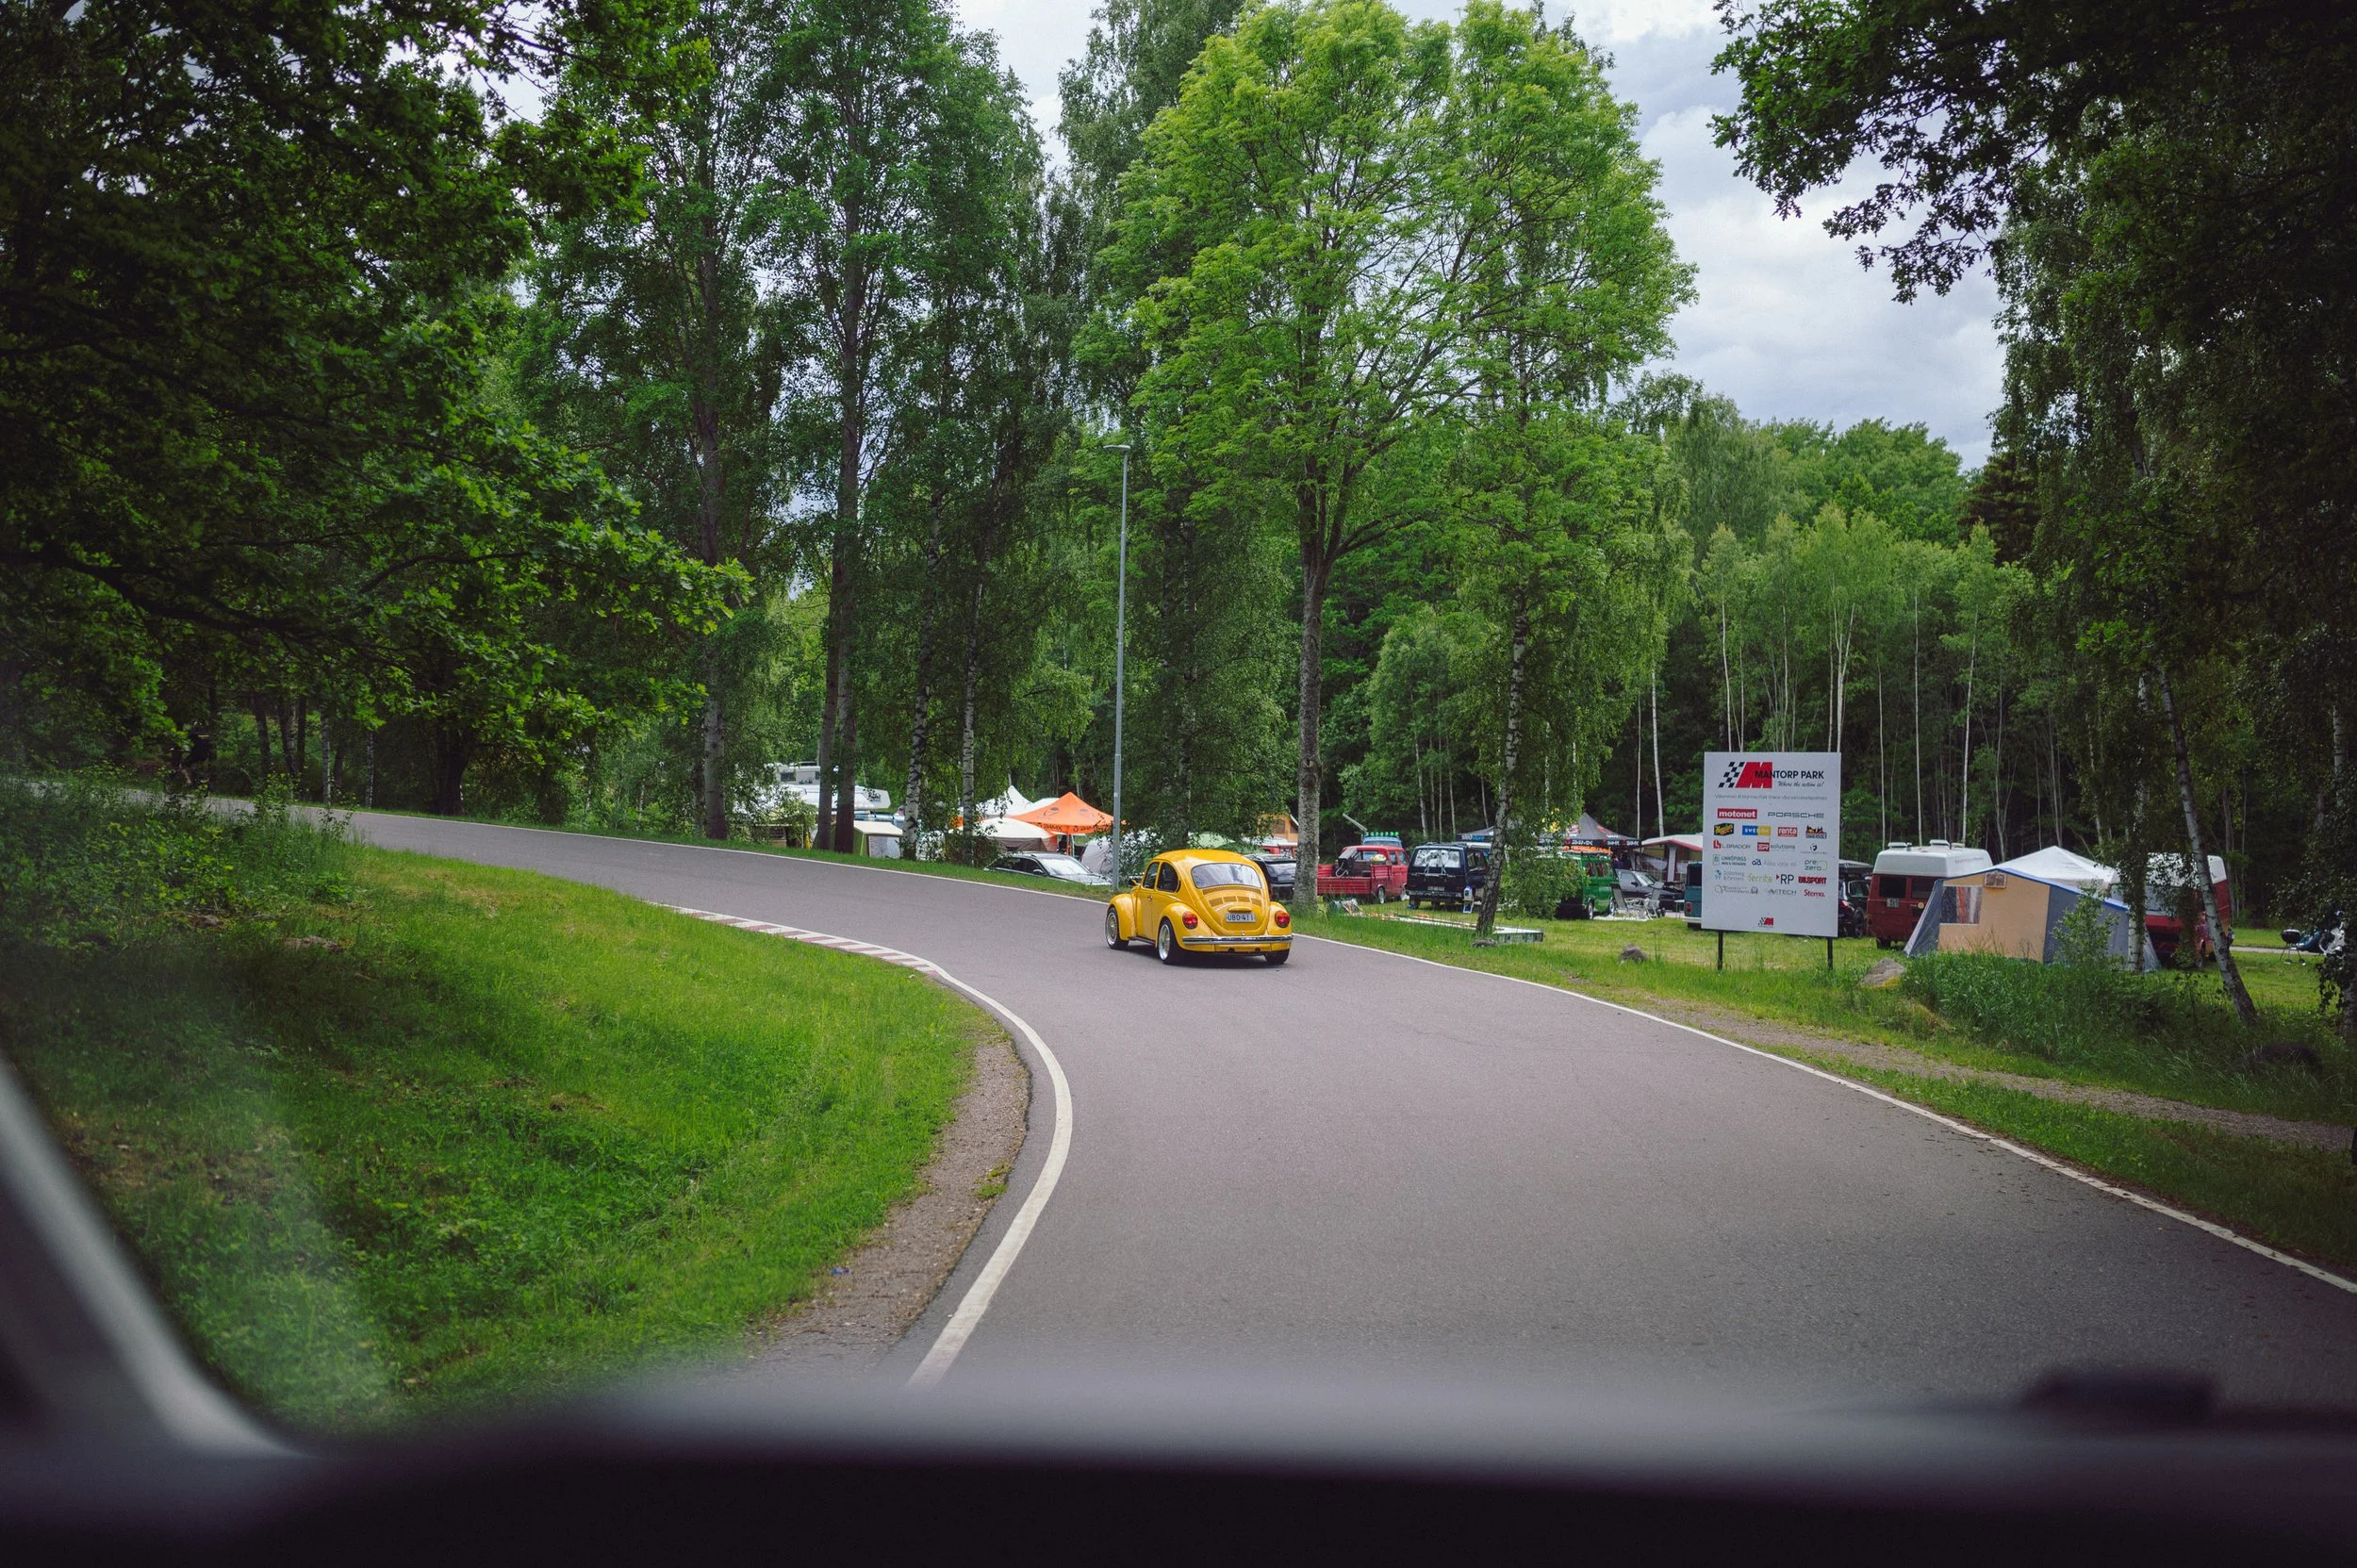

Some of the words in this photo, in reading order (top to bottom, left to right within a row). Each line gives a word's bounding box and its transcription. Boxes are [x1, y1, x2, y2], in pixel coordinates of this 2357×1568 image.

[1755, 770, 1798, 779] MANTORP
[1801, 771, 1824, 780] PARK
[1781, 874, 1795, 884] RP
[1798, 876, 1827, 884] BILSPORT
